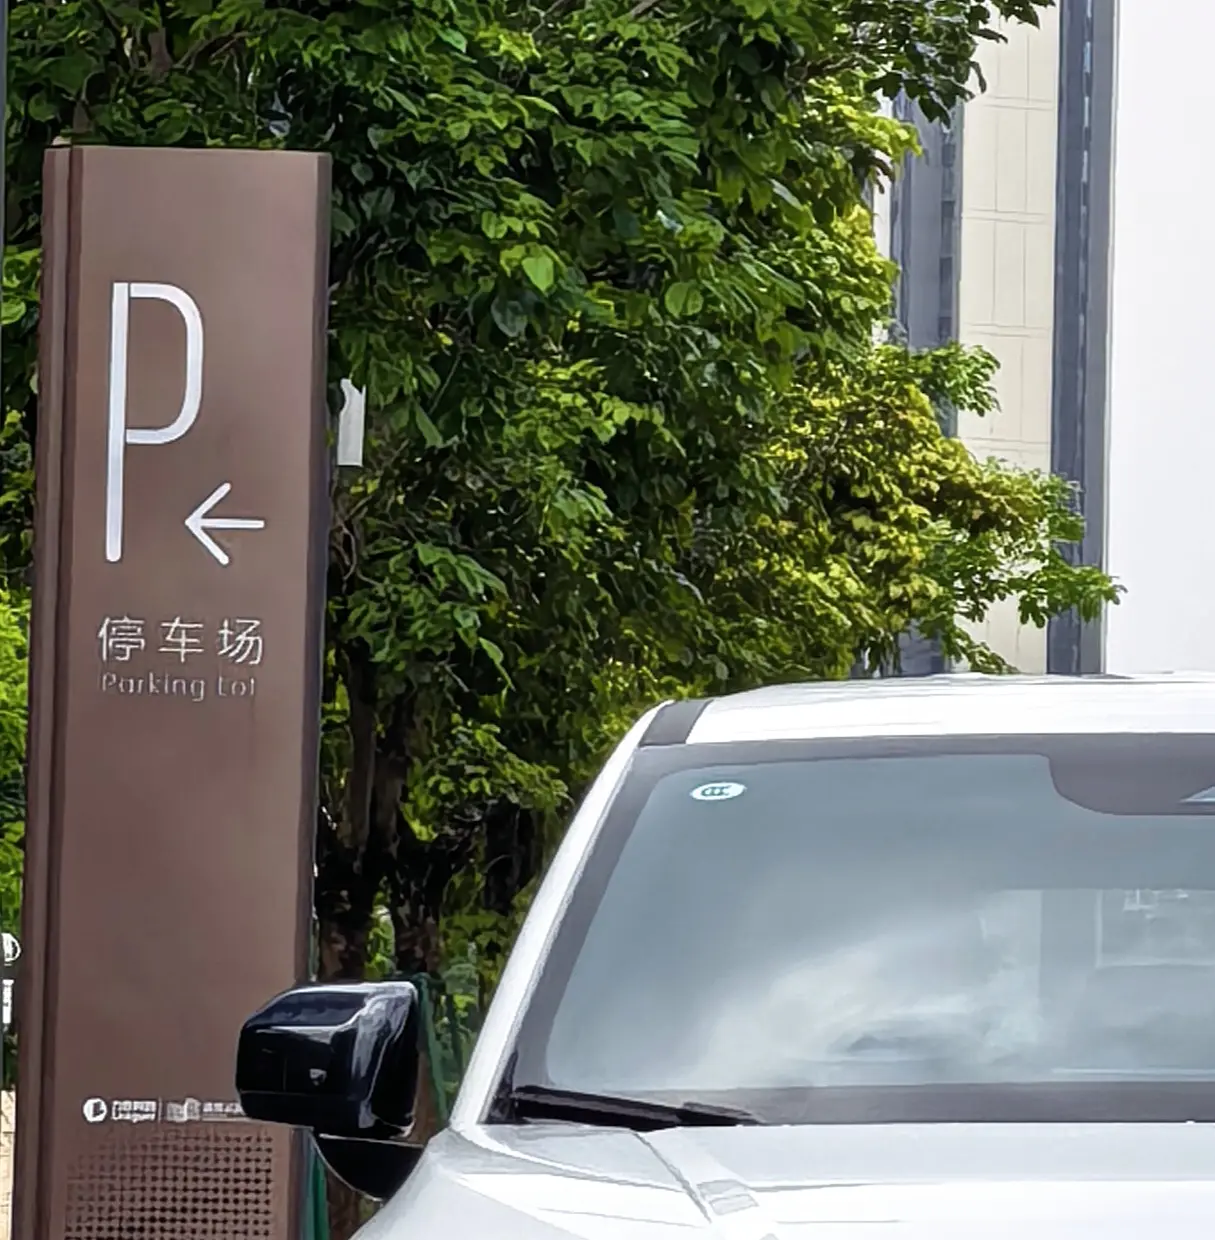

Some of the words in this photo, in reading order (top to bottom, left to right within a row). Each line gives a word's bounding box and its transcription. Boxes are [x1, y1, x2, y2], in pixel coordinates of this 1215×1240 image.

[106, 282, 204, 562] P
[98, 615, 263, 664] 停车场
[102, 671, 206, 702] Parking
